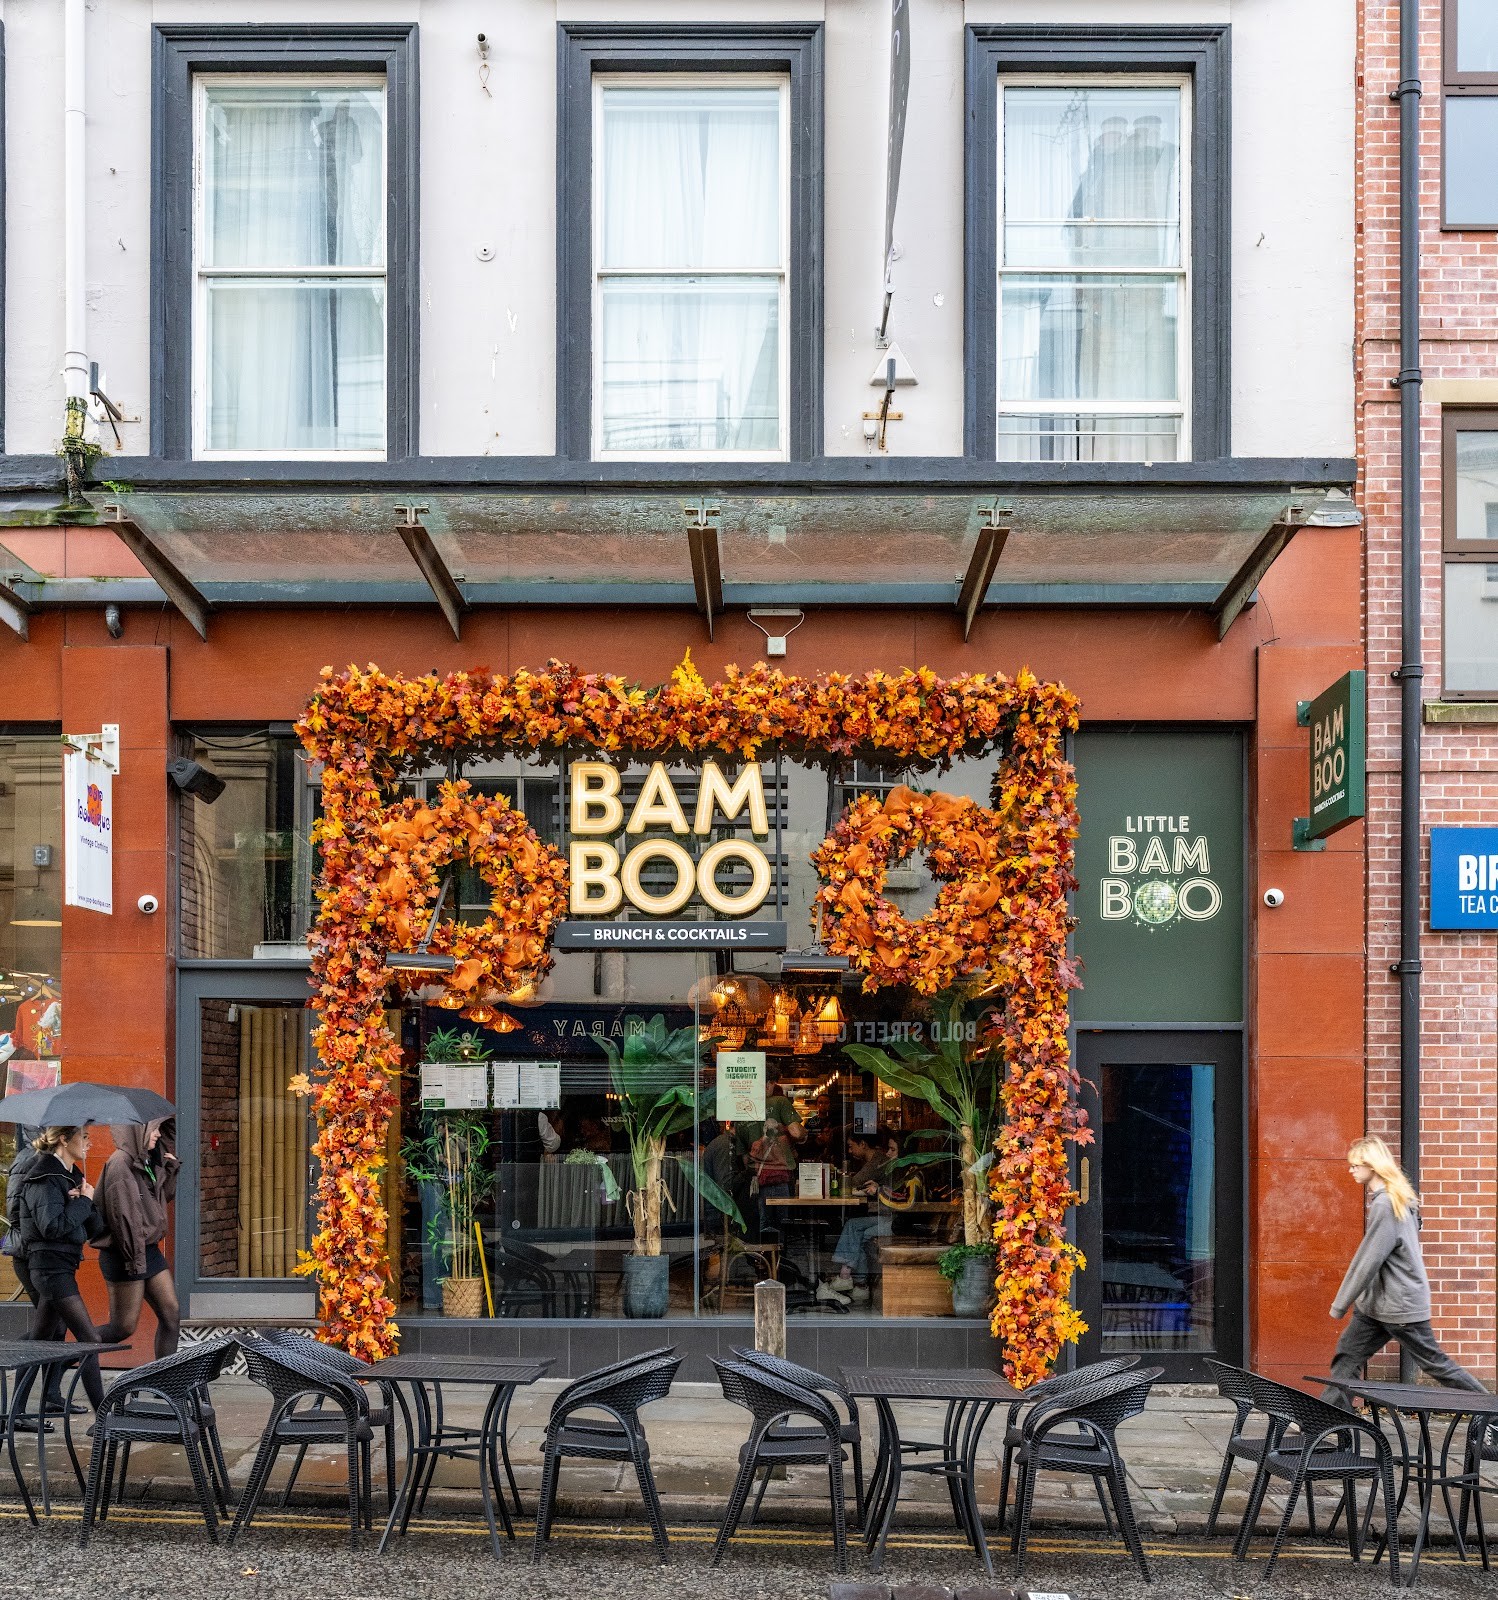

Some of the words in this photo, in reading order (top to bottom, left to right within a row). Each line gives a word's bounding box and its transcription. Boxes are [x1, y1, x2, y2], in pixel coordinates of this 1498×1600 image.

[1314, 703, 1344, 760] BAM
[1314, 746, 1345, 799] BOO
[570, 761, 769, 834] BAM
[1126, 815, 1190, 833] LITTLE
[80, 835, 94, 850] Vintage
[94, 839, 109, 854] Clothing
[1108, 835, 1211, 875] BAM
[570, 838, 771, 915] BOO
[1458, 895, 1487, 914] TEA
[594, 928, 653, 941] BRUNCH
[655, 928, 666, 941] &
[667, 928, 747, 941] COCKTAILS
